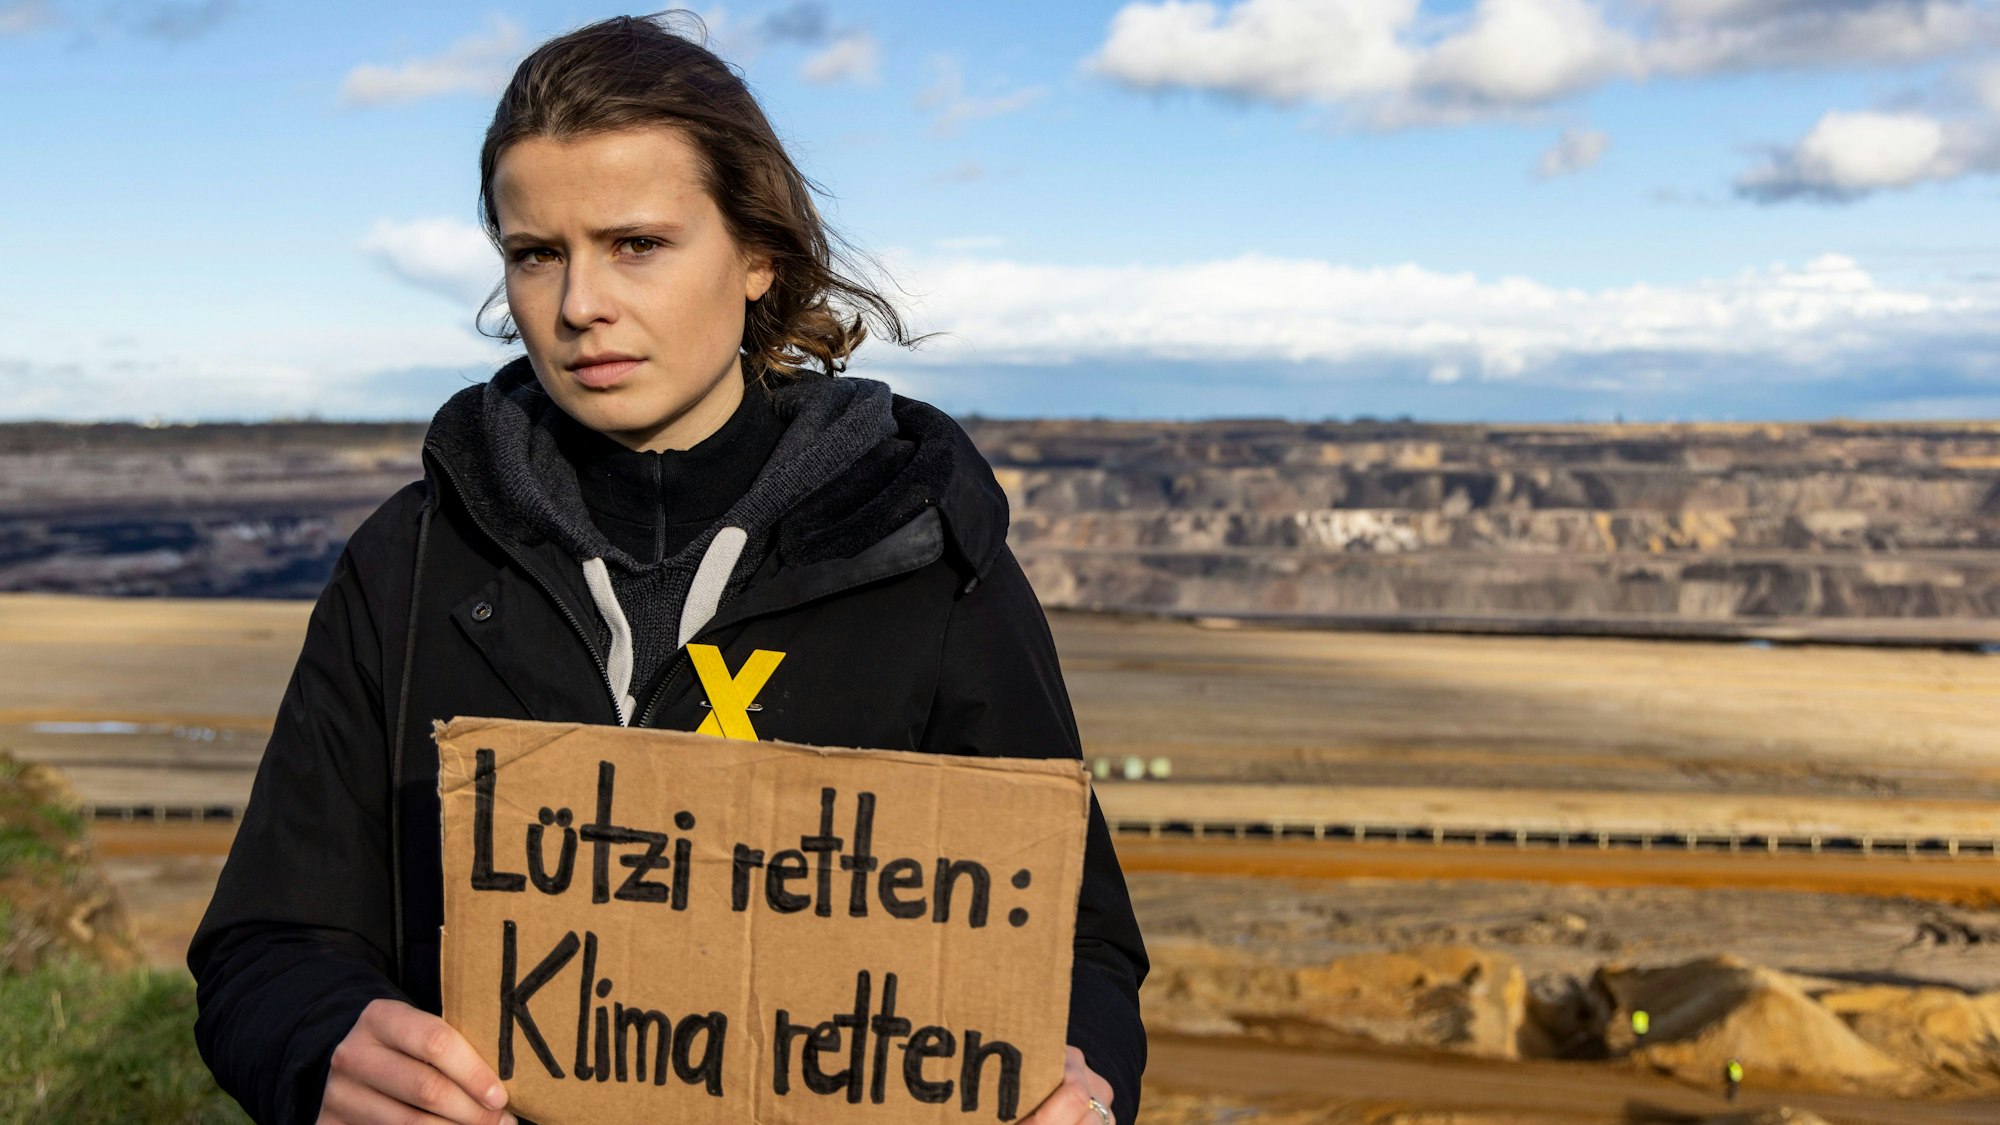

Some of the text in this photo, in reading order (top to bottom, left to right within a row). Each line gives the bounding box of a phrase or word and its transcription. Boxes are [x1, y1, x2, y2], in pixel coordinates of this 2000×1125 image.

[471, 748, 1031, 929] Lützi retten:
[499, 919, 1022, 1122] Klima retten
